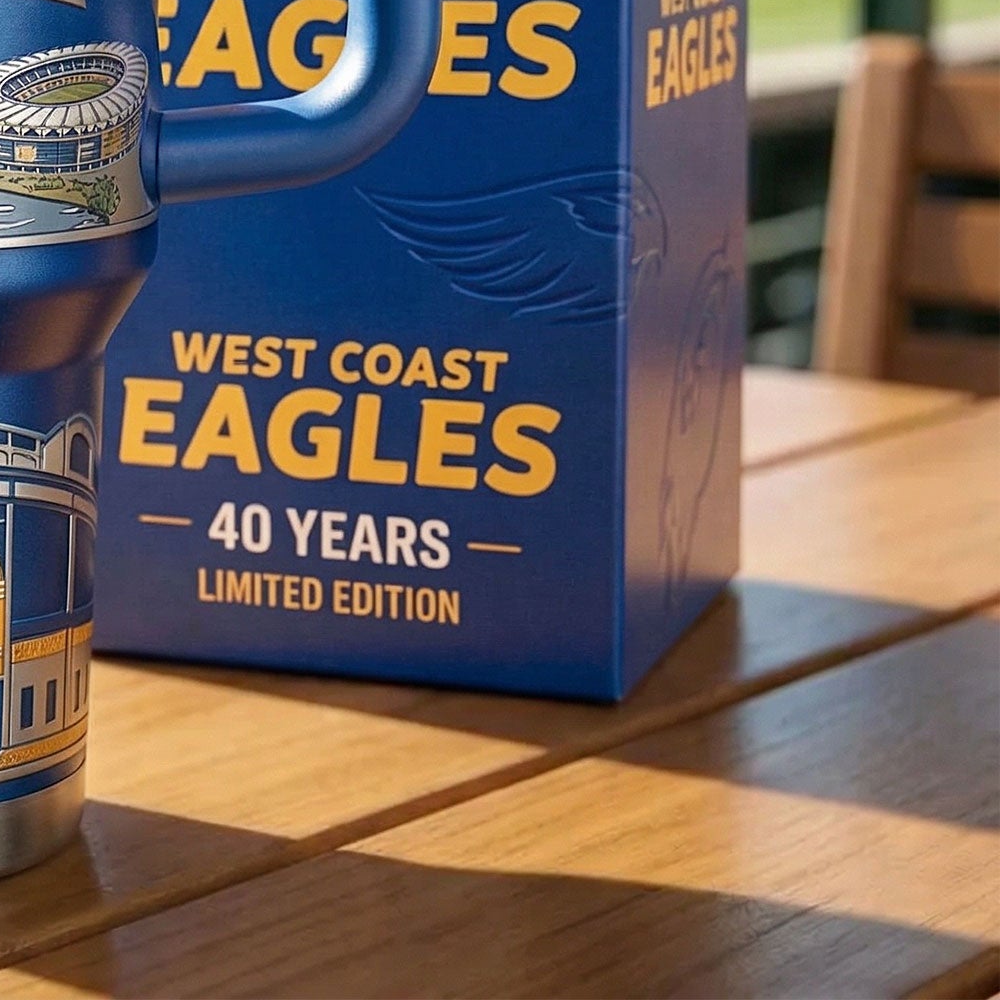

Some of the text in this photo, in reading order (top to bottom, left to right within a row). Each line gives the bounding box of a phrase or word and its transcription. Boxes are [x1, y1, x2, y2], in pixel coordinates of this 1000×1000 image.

[646, 4, 739, 110] EAGLES
[171, 331, 508, 392] WEST COAST
[119, 377, 561, 497] EAGLES
[208, 501, 451, 569] 40 YEARS
[198, 568, 460, 625] LIMITED EDITION
